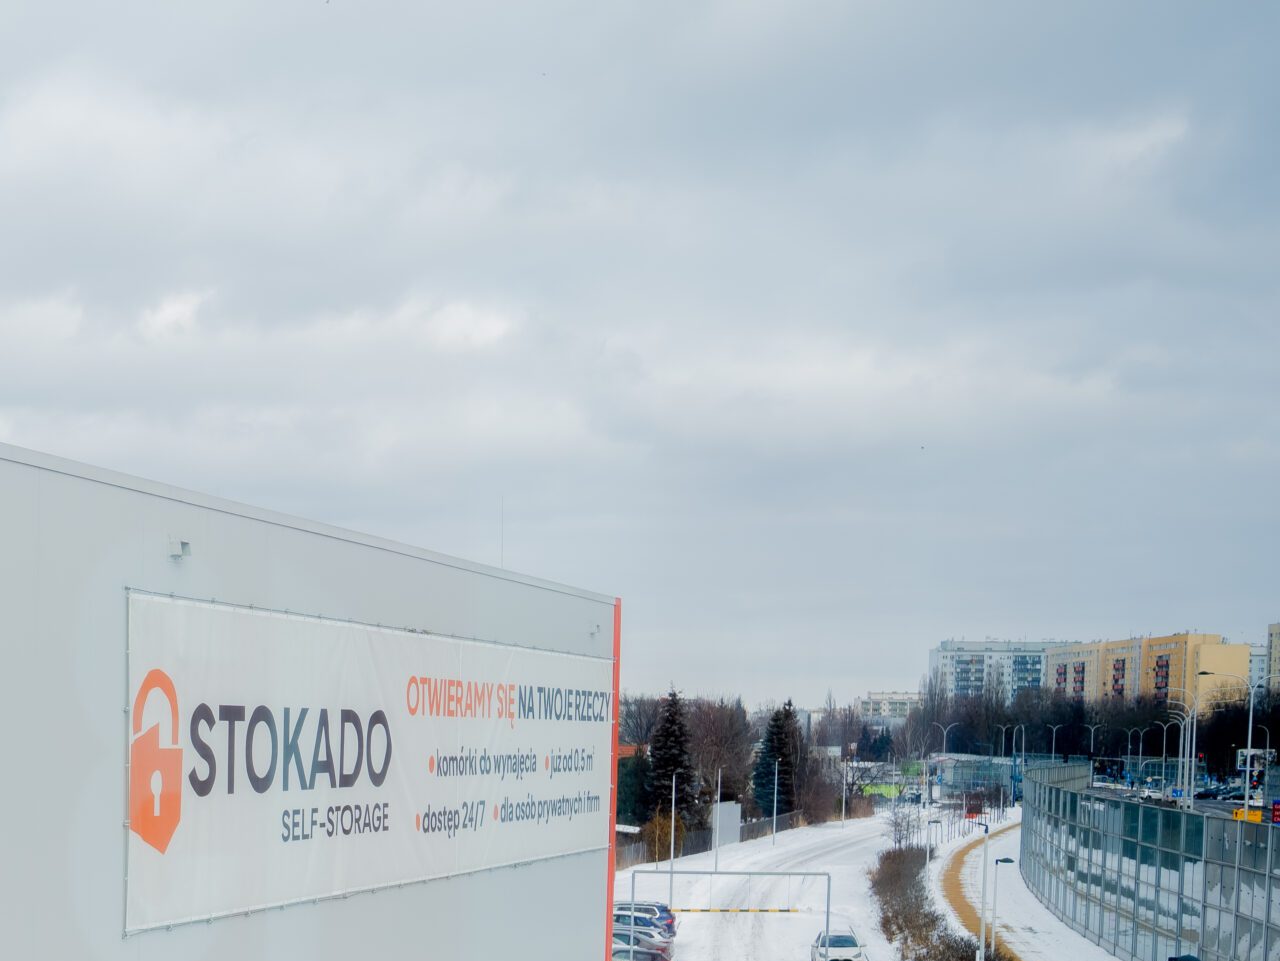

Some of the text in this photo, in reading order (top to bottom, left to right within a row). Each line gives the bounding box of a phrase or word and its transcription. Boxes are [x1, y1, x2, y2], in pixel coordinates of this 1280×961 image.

[406, 675, 612, 730] OTWIERAMY SIĘ NA TWOJE RZECZY
[188, 702, 393, 798] STOKADO
[436, 746, 537, 781] komórki do wynajęcia
[549, 747, 562, 780] już
[562, 748, 573, 773] od
[281, 802, 389, 843] SELF-STORAGE
[422, 800, 486, 839] dostęp 24/7
[500, 797, 514, 823] dla
[515, 793, 536, 821] osób
[537, 791, 583, 824] prywatnych
[587, 790, 600, 813] firm
